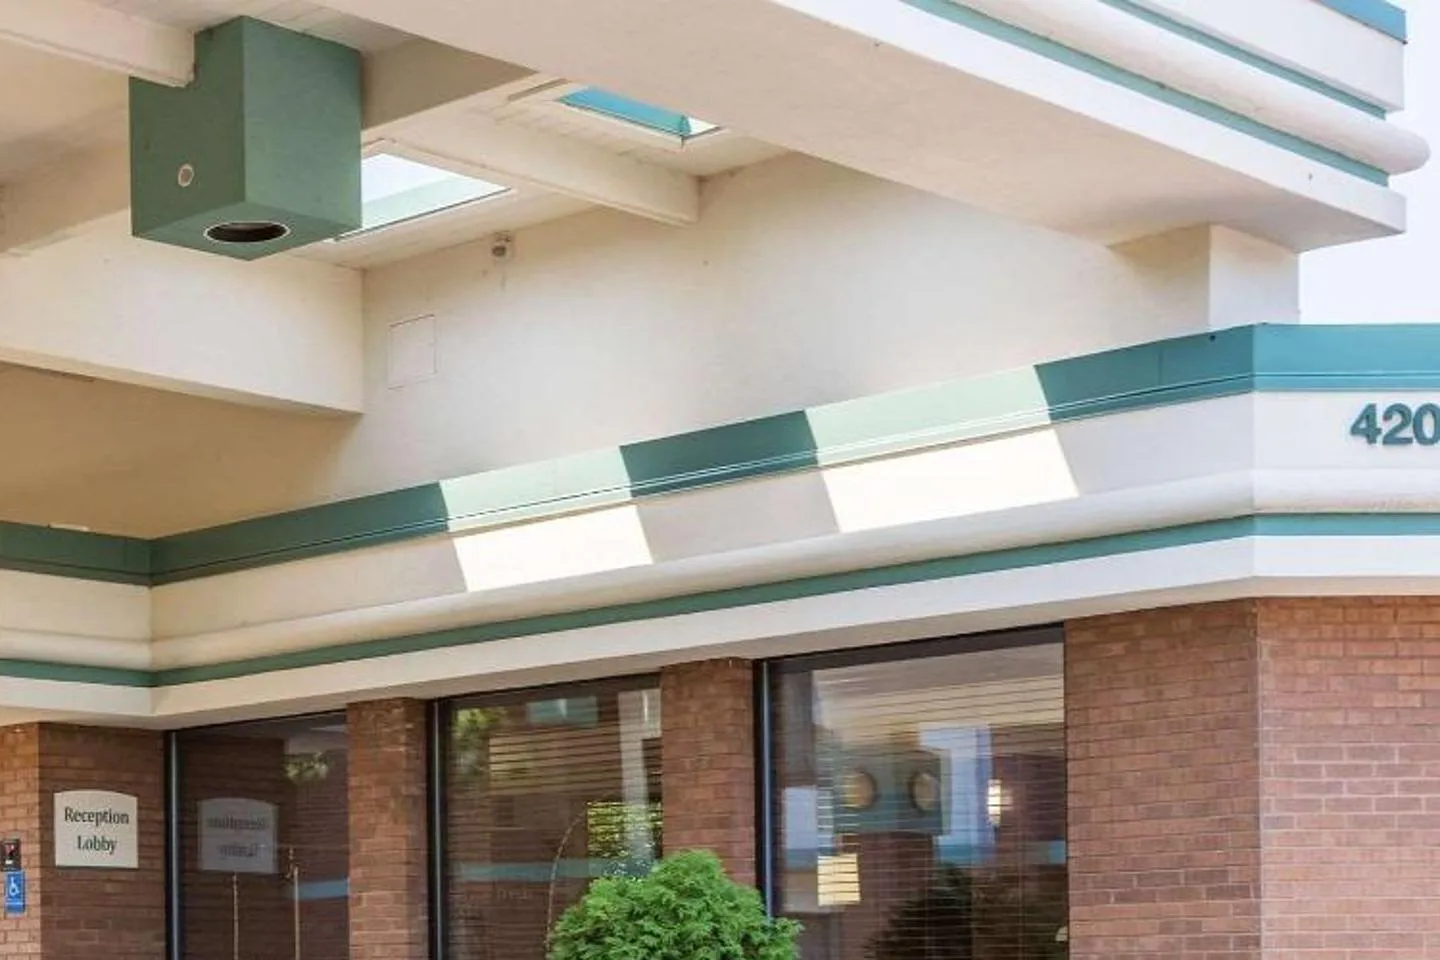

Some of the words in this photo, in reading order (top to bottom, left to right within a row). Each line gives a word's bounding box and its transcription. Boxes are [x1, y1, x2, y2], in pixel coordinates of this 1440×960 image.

[1349, 402, 1440, 446] 420
[63, 806, 130, 827] Reception
[77, 835, 118, 856] Lobby
